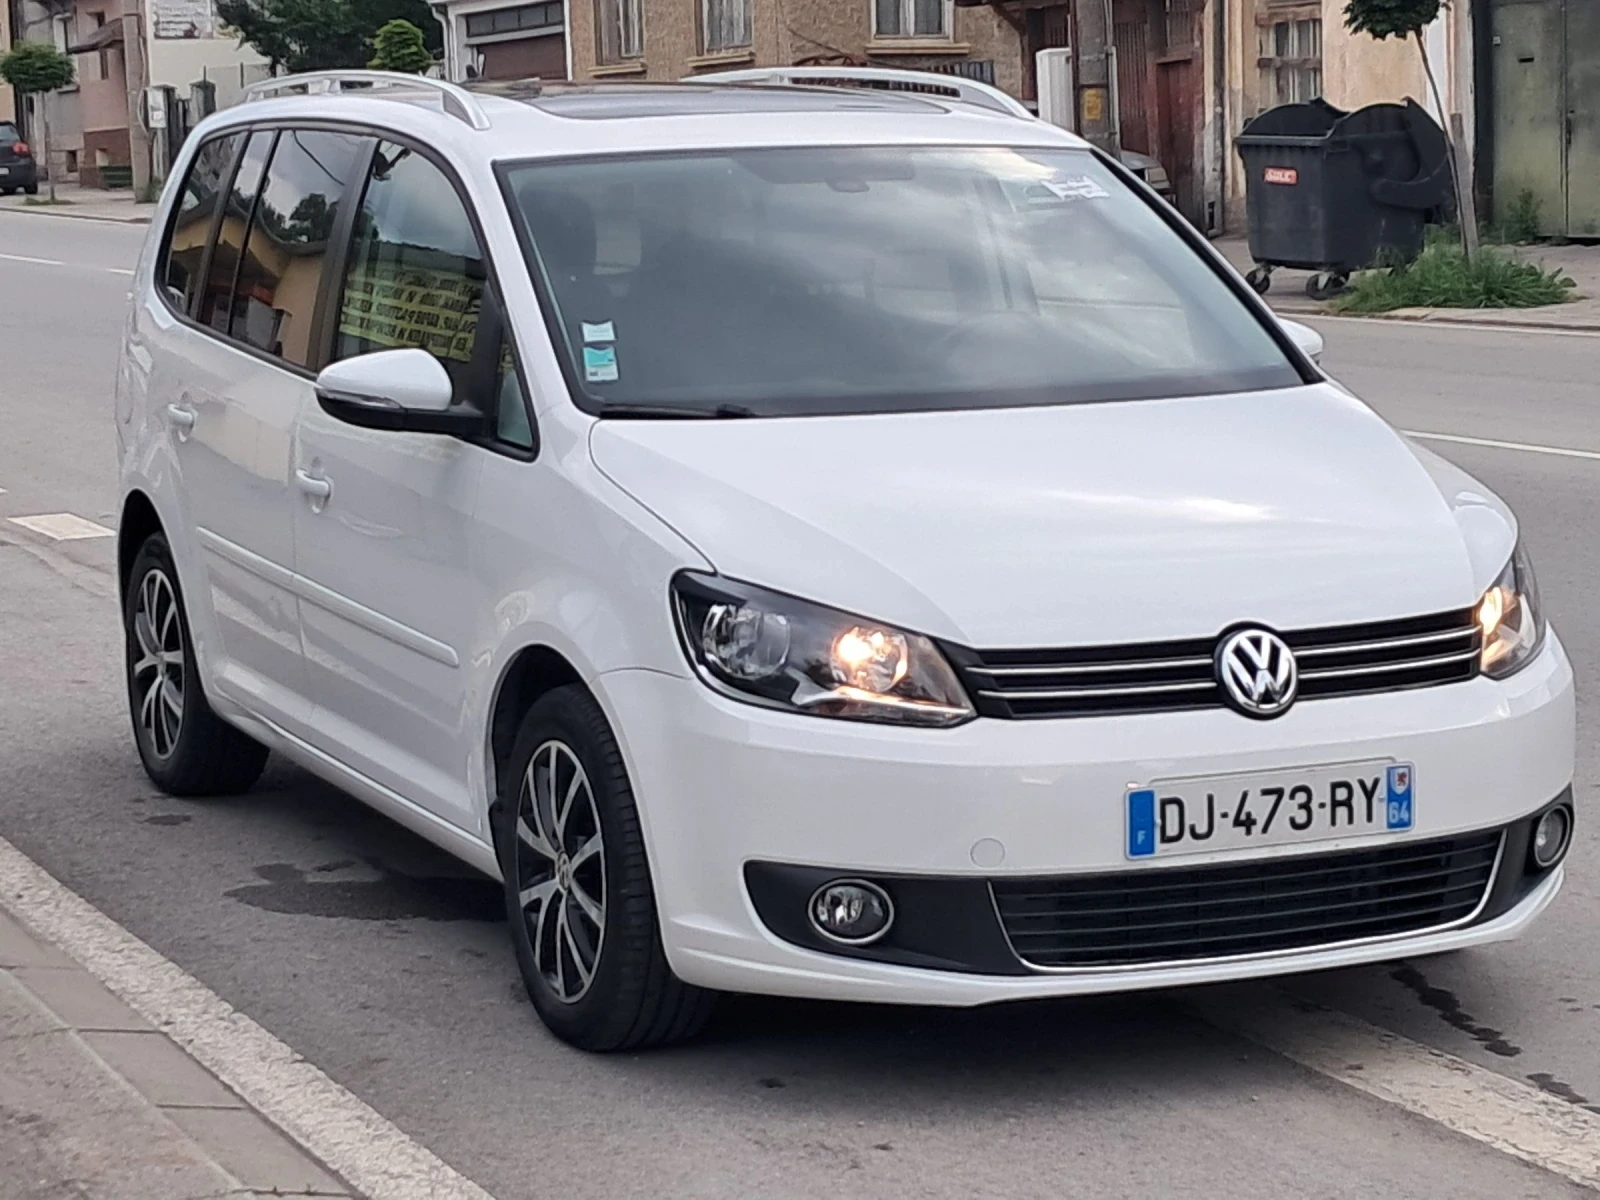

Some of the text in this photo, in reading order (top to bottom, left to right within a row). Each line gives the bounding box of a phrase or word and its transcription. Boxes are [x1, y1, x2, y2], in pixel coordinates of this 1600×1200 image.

[1160, 777, 1380, 844] DJ-473-RY
[1388, 800, 1409, 823] 64
[1136, 831, 1146, 844] F
